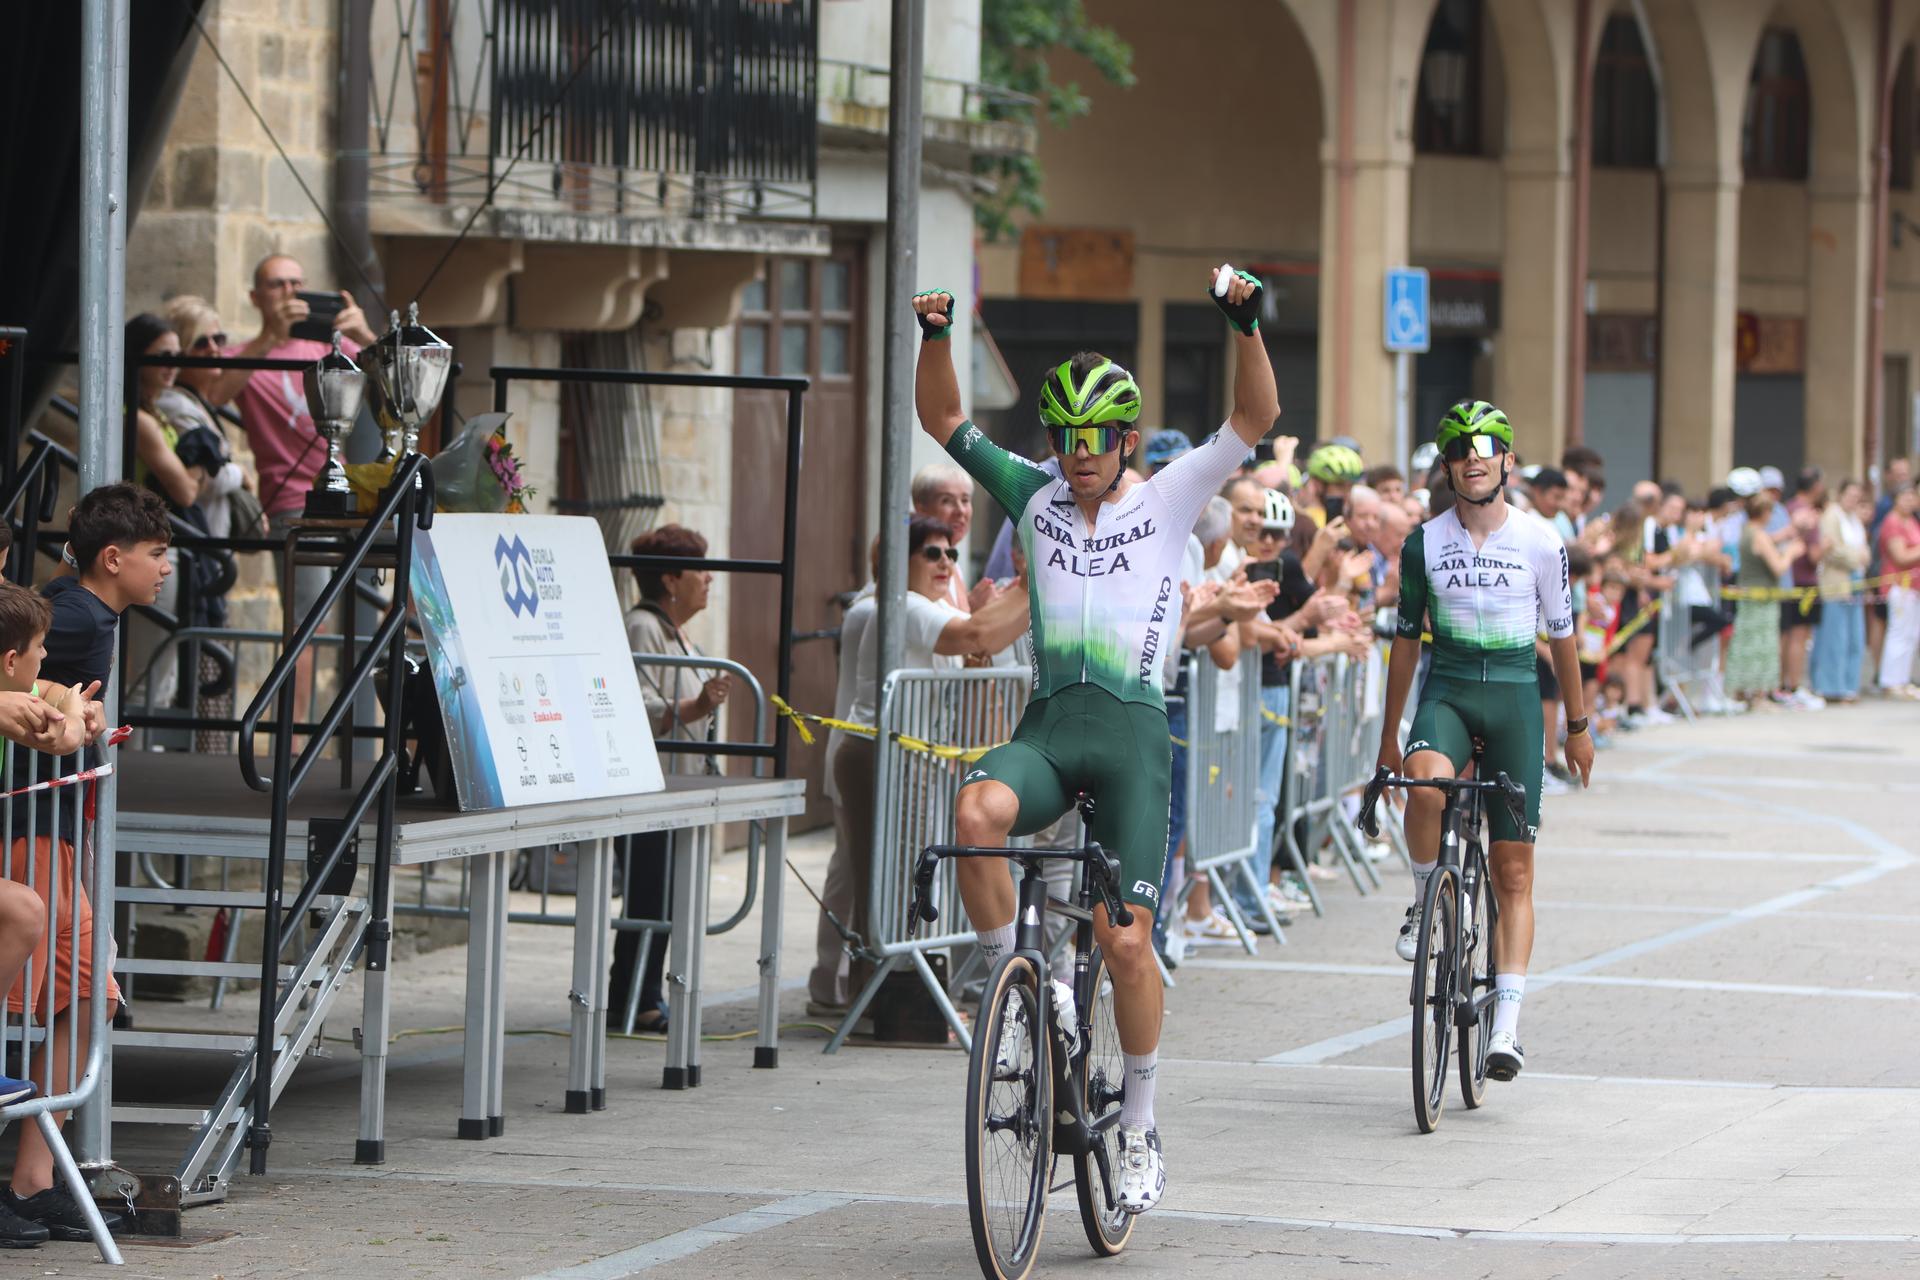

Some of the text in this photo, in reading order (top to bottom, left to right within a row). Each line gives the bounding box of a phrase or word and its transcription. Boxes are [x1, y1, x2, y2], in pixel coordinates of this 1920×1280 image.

[1033, 514, 1156, 553] CAJA RURAL
[531, 548, 555, 564] GORLA
[1047, 547, 1131, 577] ALEA
[535, 566, 554, 583] AUTO
[1446, 573, 1510, 589] ALEA
[538, 584, 563, 601] GROUP
[1139, 576, 1172, 691] CAJA RURAL
